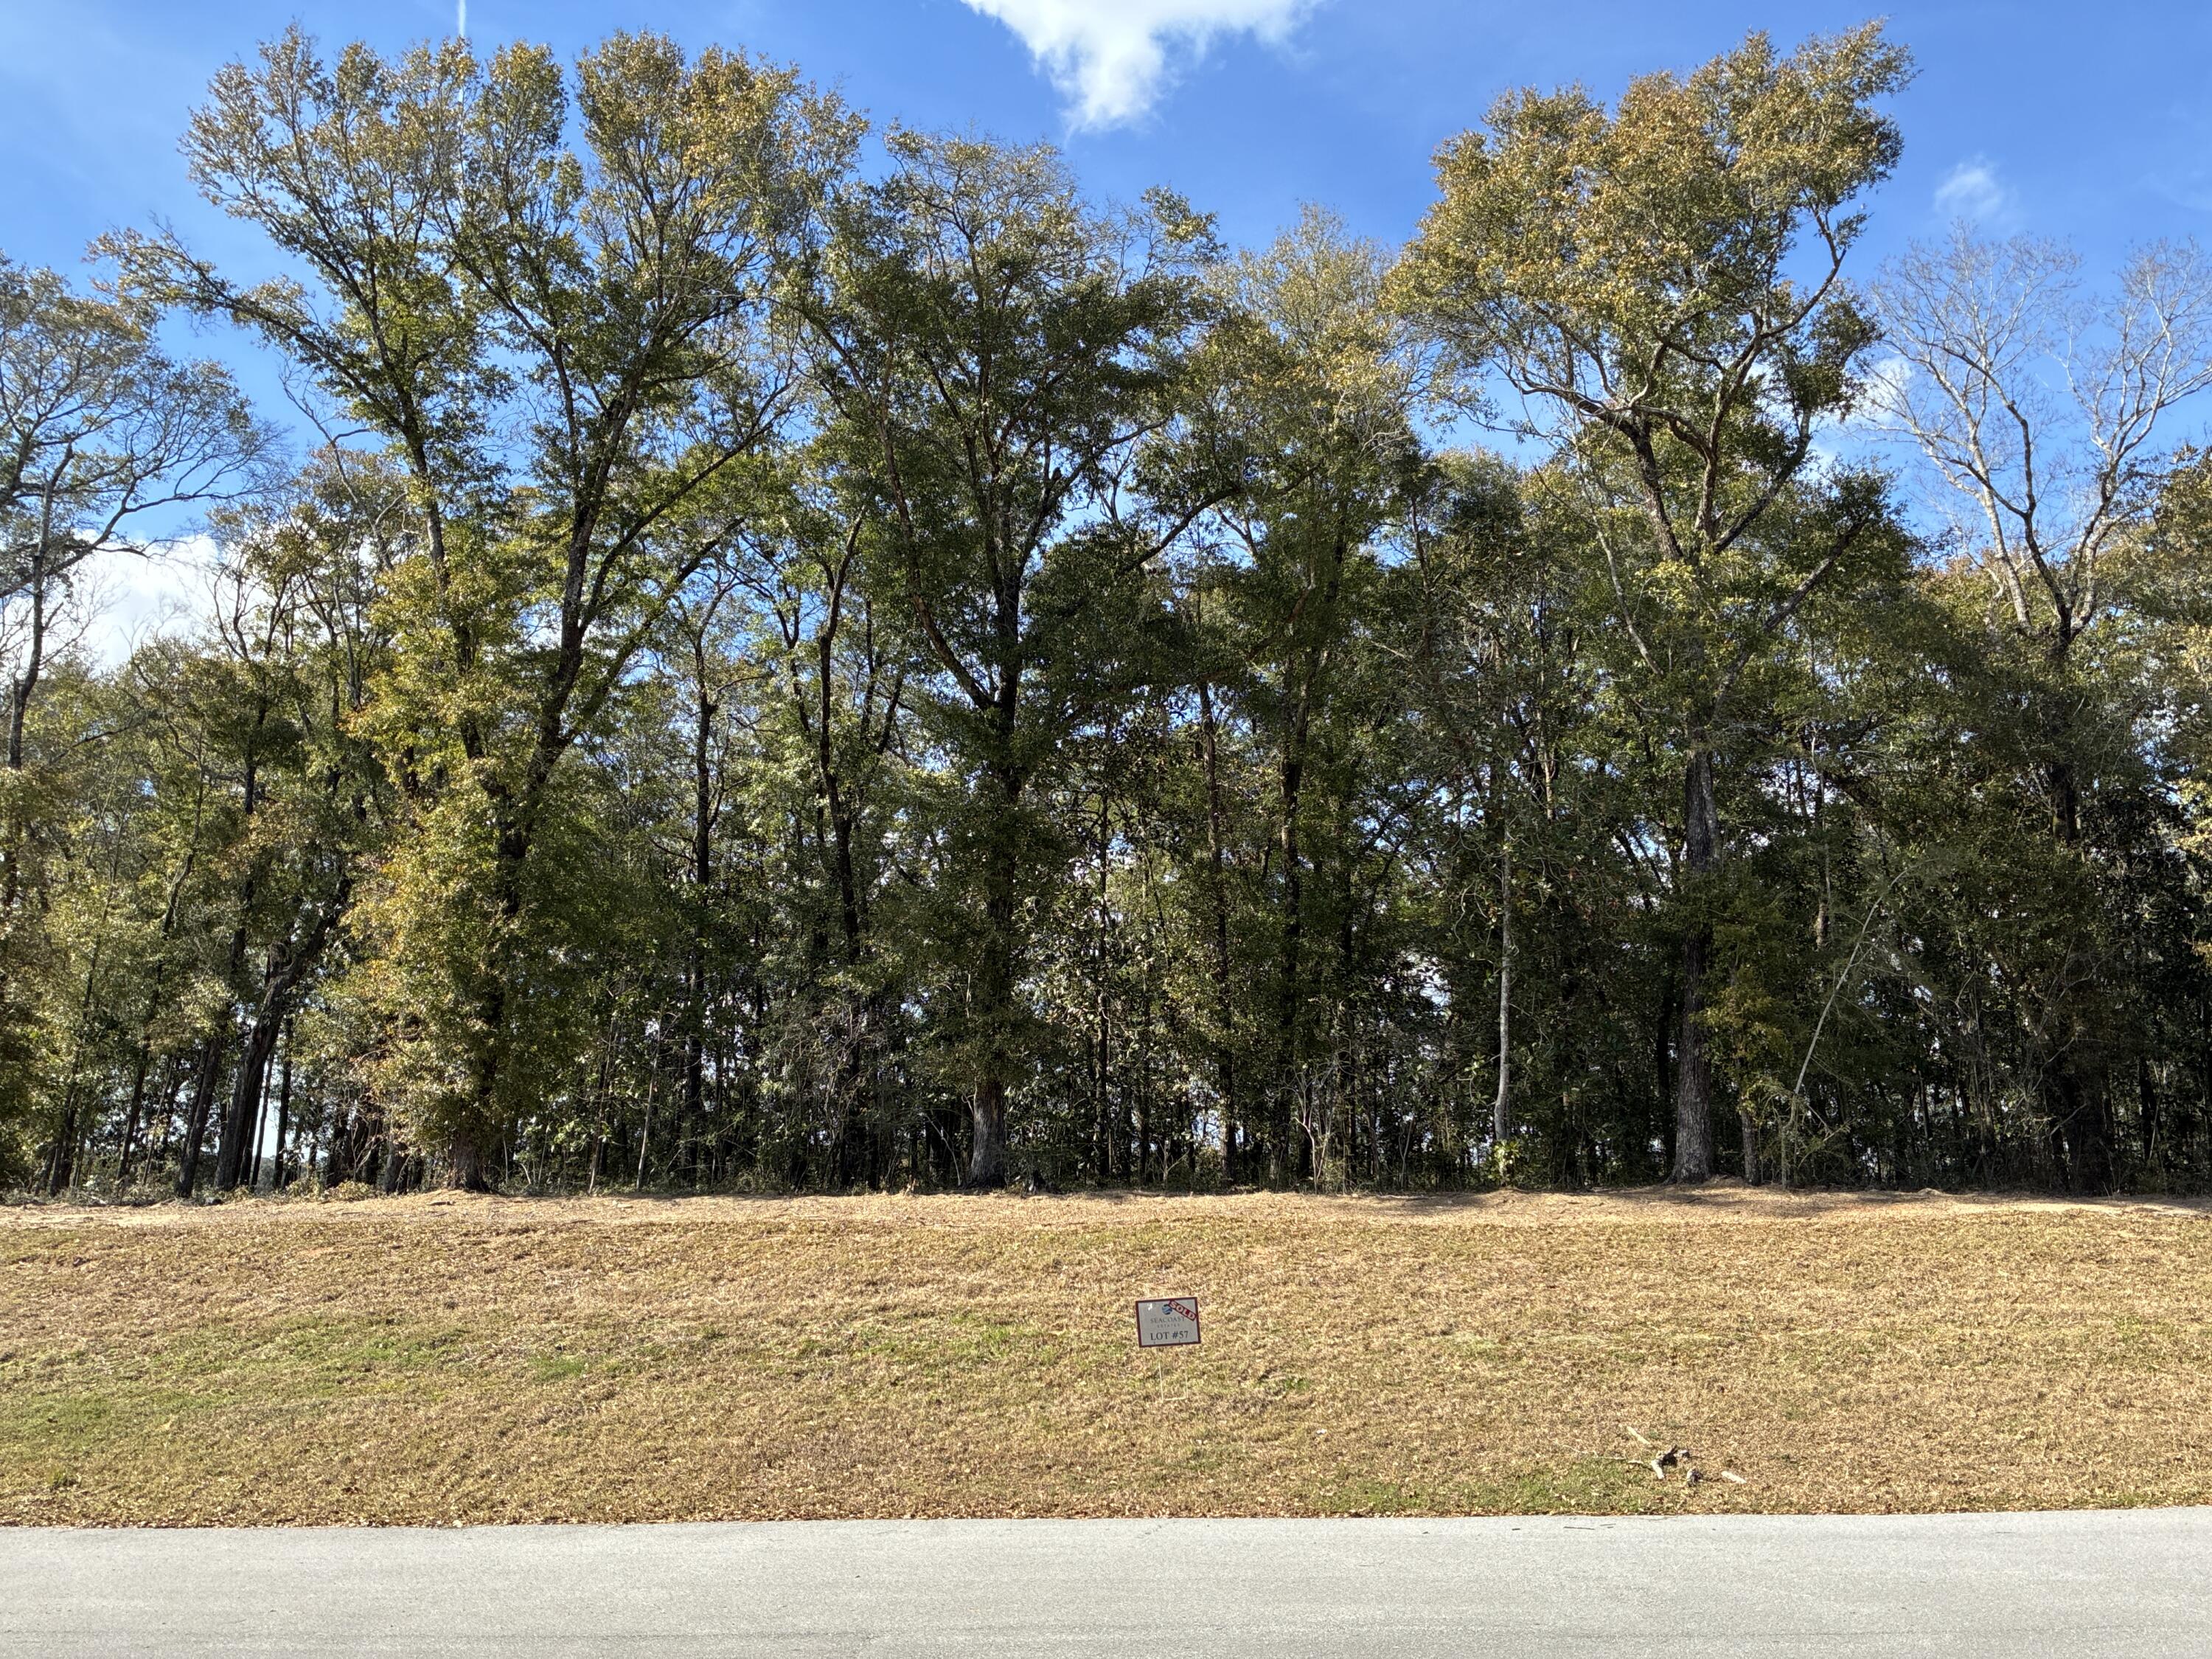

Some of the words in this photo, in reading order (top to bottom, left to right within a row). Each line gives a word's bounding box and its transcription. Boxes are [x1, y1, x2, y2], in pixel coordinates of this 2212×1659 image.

[1169, 1301, 1196, 1319] SOLD
[1150, 1332, 1169, 1340] LOT
[1172, 1330, 1189, 1339] #57
